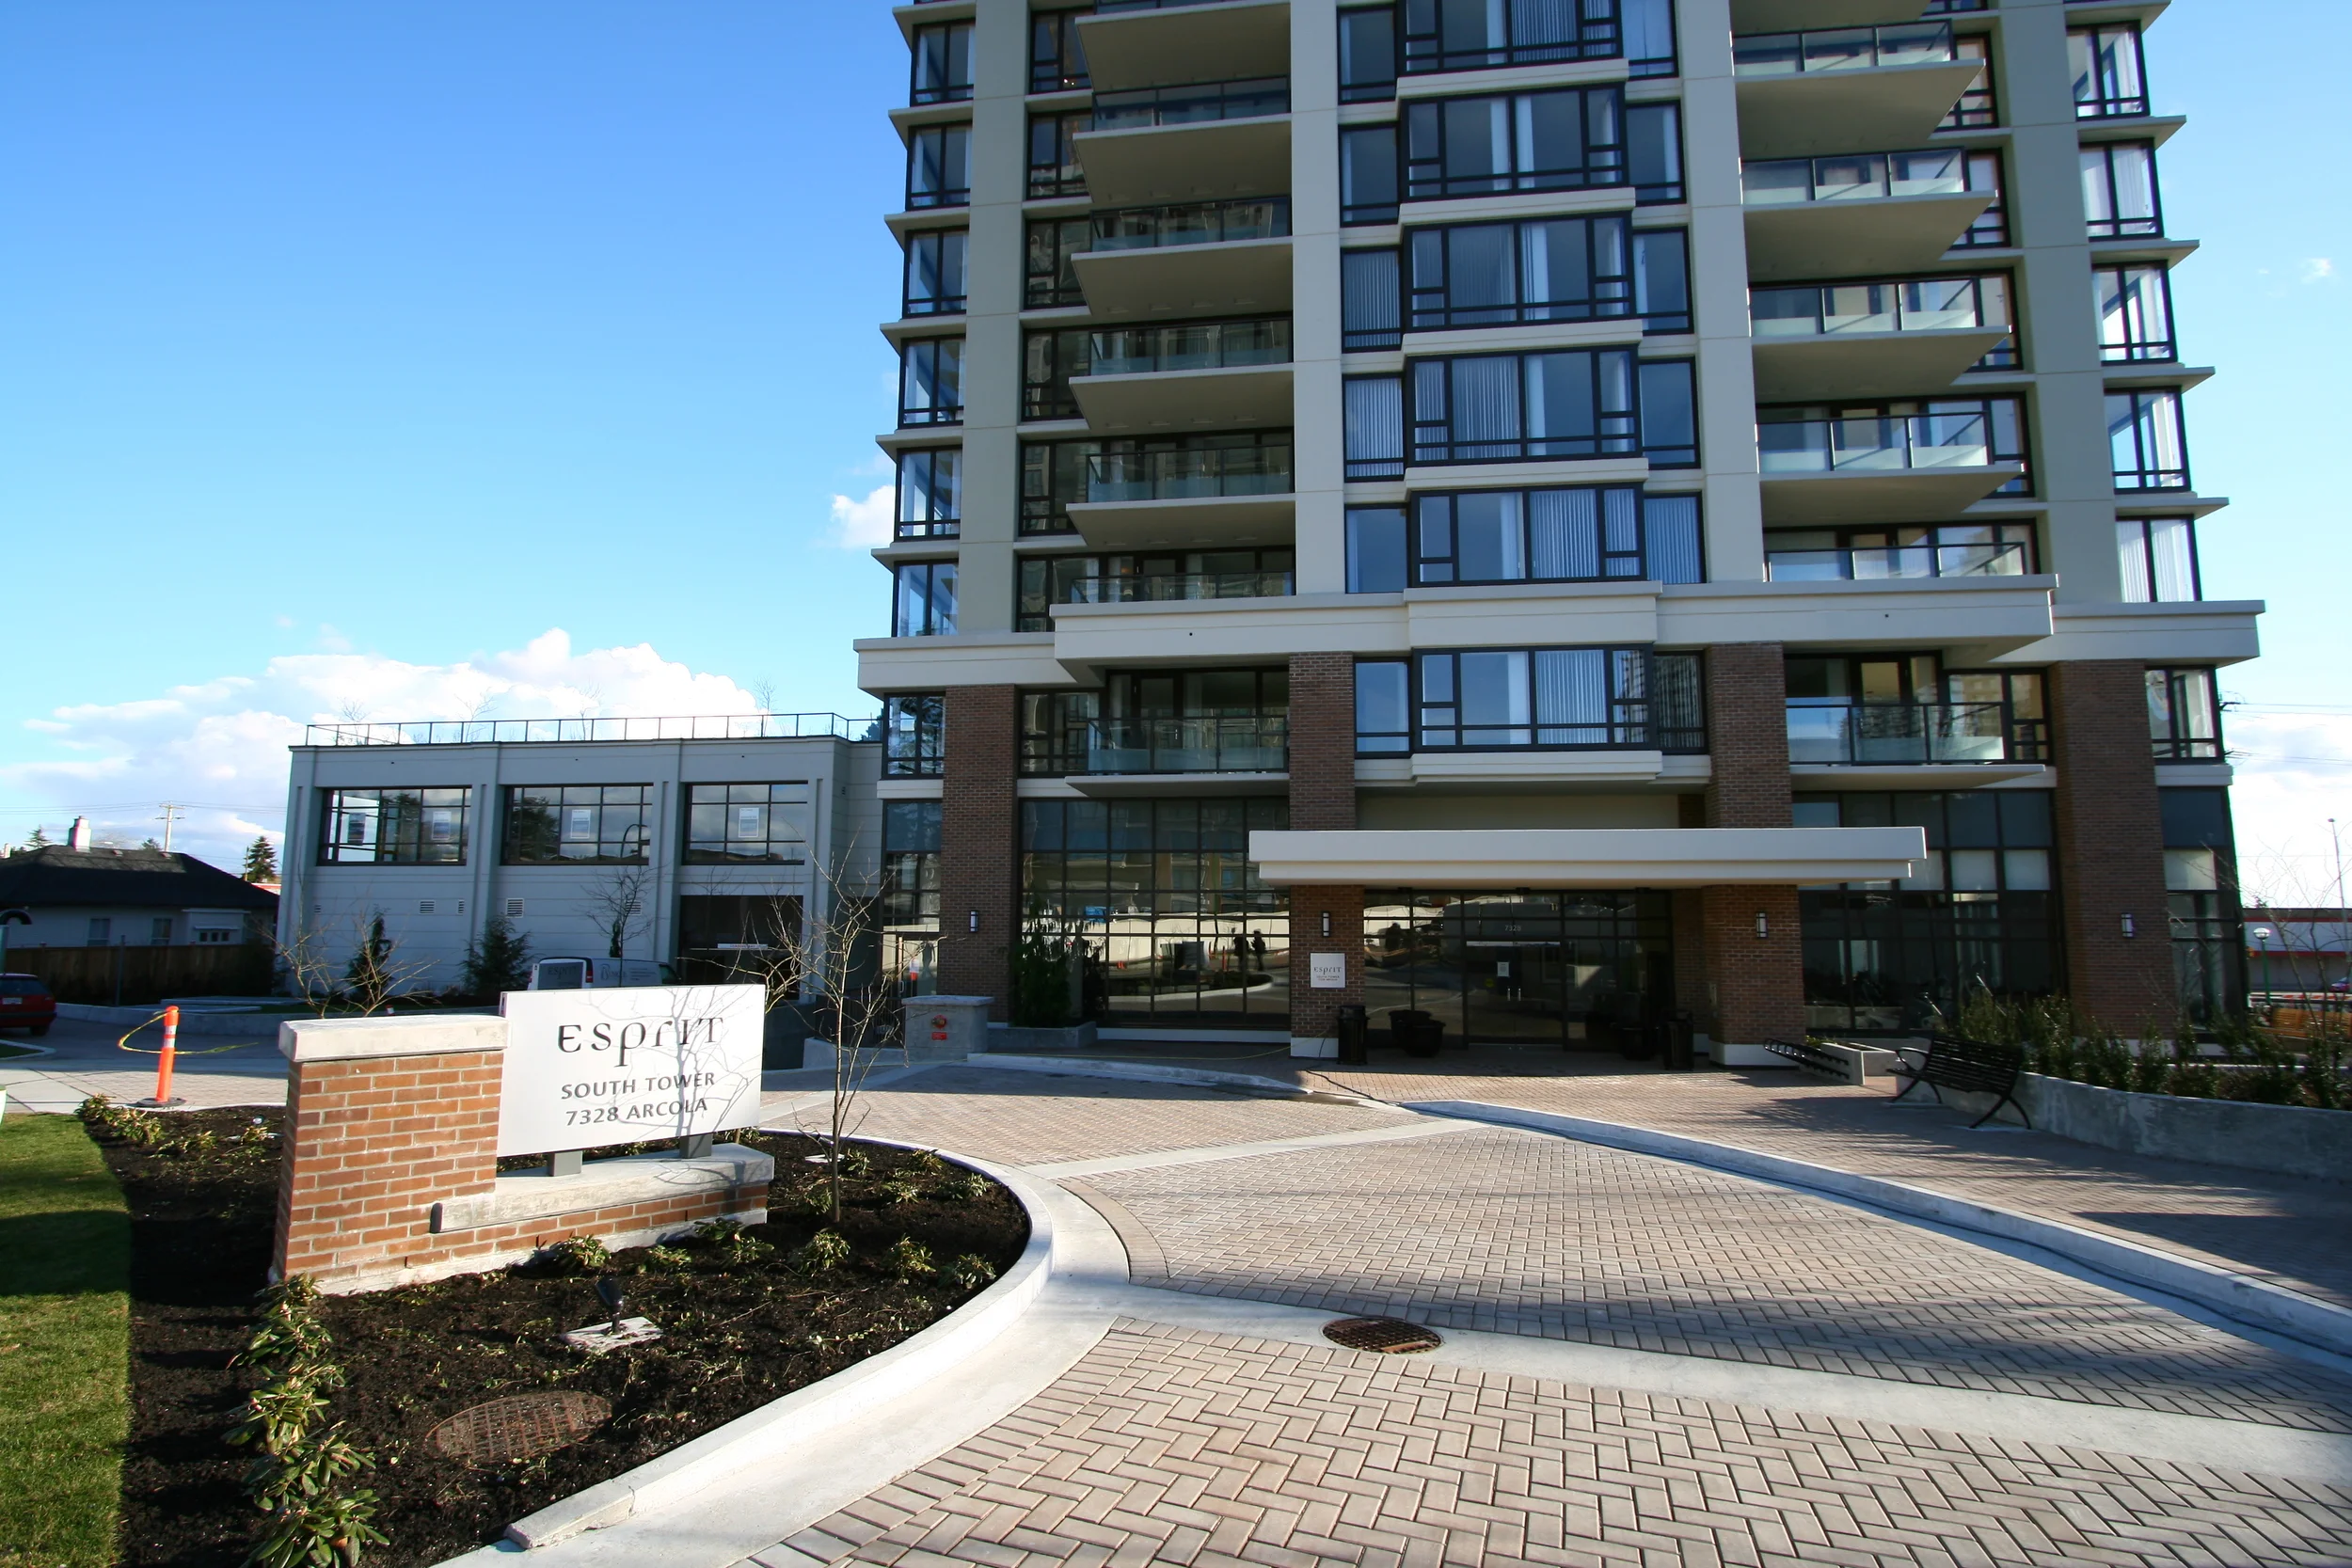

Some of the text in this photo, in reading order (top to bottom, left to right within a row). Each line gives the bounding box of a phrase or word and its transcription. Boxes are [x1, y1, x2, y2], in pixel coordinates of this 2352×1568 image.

[561, 1071, 716, 1100] SOUTH TOWER
[565, 1098, 707, 1127] 7328 ARCOLA
